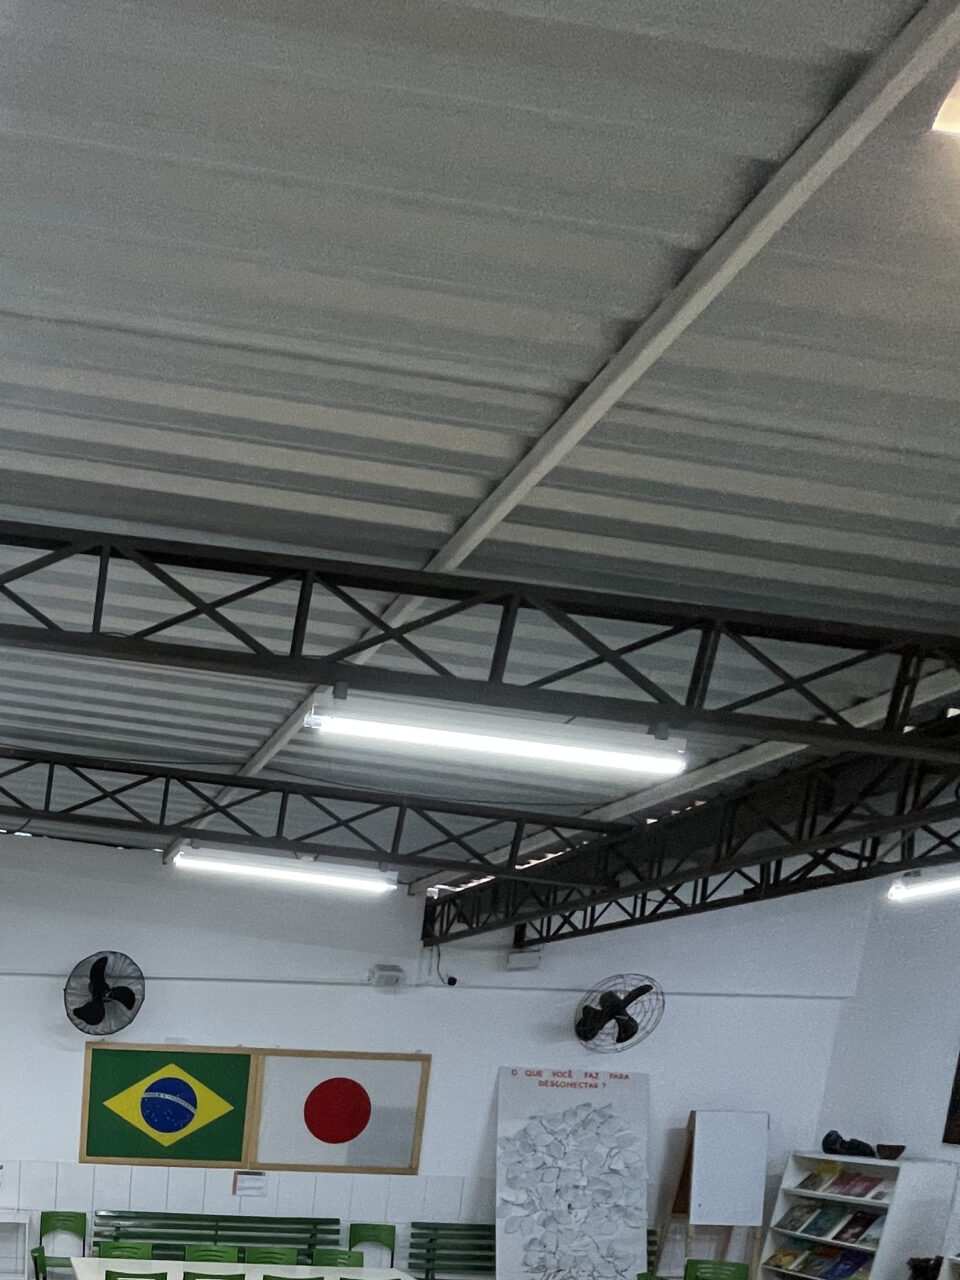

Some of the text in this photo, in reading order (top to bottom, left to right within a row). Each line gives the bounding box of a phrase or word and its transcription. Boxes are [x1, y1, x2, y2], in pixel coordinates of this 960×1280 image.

[525, 1069, 542, 1077] QUE
[552, 1069, 572, 1078] VOCÊ
[584, 1071, 599, 1079] FAZ
[609, 1072, 629, 1080] PARA
[538, 1080, 598, 1088] DESCONECTAR
